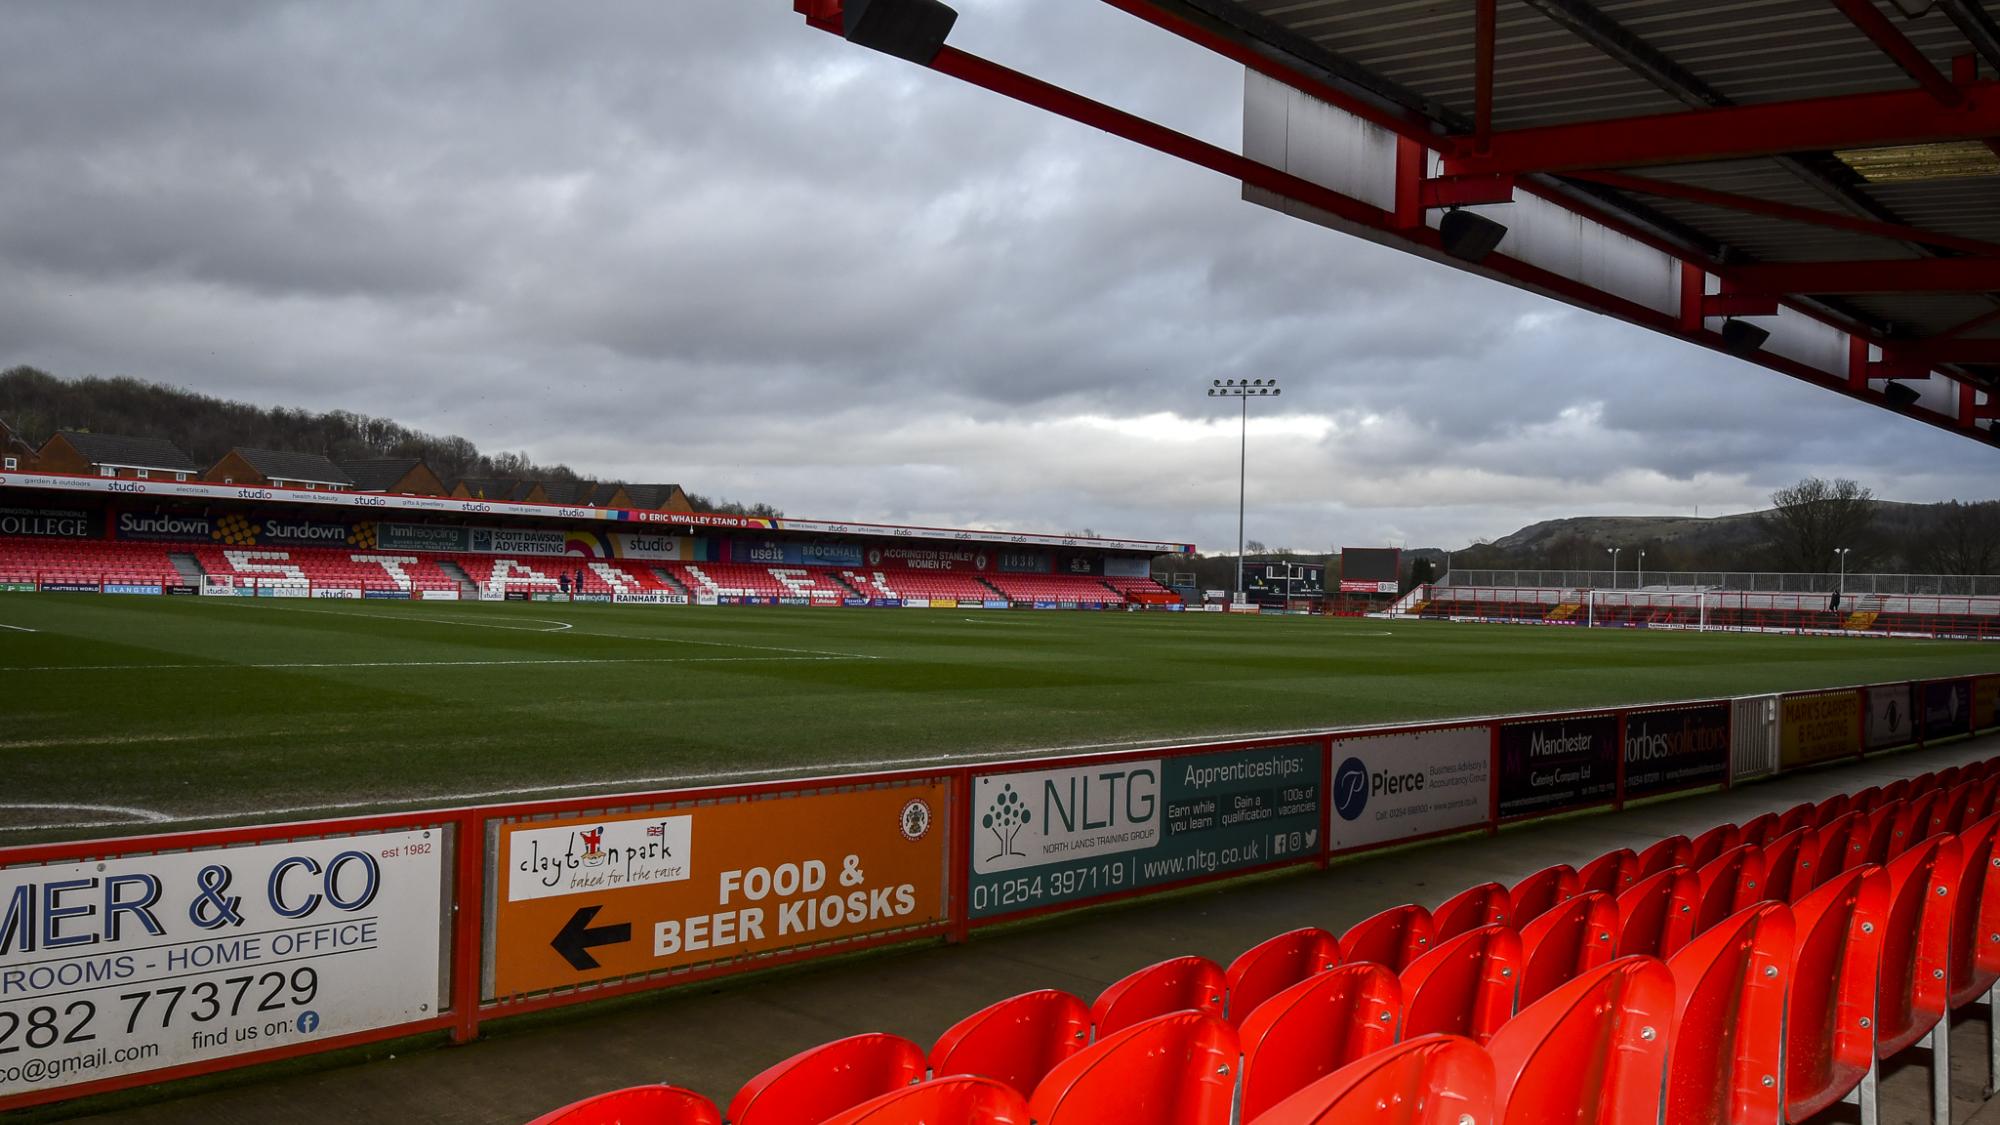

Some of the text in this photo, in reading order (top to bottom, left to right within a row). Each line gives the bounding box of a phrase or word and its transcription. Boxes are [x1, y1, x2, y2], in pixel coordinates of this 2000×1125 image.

[108, 481, 146, 493] studio
[238, 488, 273, 500] studio
[354, 495, 386, 506] studio
[462, 502, 491, 513] studio
[559, 508, 585, 518] studio
[649, 513, 738, 527] ERIC WHALLEY STAND
[2, 516, 88, 536] OLLEGE
[120, 512, 208, 534] Sundown
[265, 520, 345, 539] Sundown
[494, 531, 521, 541] SCOTT
[523, 532, 564, 543] DAWSON
[630, 538, 674, 552] studio
[494, 541, 564, 554] ADVERTISING
[751, 548, 784, 561] useit
[802, 545, 862, 558] BROCKHALL
[883, 548, 975, 563] ACCRINGTON STANLEY
[907, 559, 952, 570] WOMEN FC
[112, 586, 160, 594] LANGTEC
[206, 588, 230, 596] studio
[320, 590, 353, 599] studio
[616, 595, 686, 603] RAINHAM STEEL
[1530, 724, 1593, 758] Manchester
[1184, 755, 1304, 790] Apprenticeships:
[1429, 764, 1456, 777] Business
[1457, 760, 1482, 772] Advisory
[1530, 763, 1592, 787] Catering Company Ltd
[1371, 769, 1426, 797] Pierce
[1429, 773, 1488, 788] Accountancy Group
[1043, 769, 1156, 836] NLTG
[1234, 794, 1261, 809] Gain a
[1283, 786, 1314, 802] 100s of
[1168, 799, 1216, 819] Earn while
[1278, 799, 1317, 816] vacancies
[1170, 814, 1213, 837] you learn
[1222, 807, 1273, 828] qualification
[381, 842, 432, 859] est 1982
[1043, 829, 1155, 855] NORTH LANCS TRAINING GROUP
[625, 822, 673, 883] park
[569, 864, 683, 890] baked for the taste
[719, 853, 866, 906] FOOD &
[974, 840, 1260, 910] 01254 397119 www.nltg.co.uk
[189, 864, 246, 931] &
[267, 850, 381, 920] CO
[653, 883, 917, 958] BEER KIOSKS
[3, 954, 136, 994] ROOMS
[168, 936, 261, 972] HOME
[271, 921, 379, 957] OFFICE
[0, 966, 319, 1055] 282 773729
[192, 1017, 294, 1051] find us on:
[0, 1041, 159, 1084] co@gmail.com
